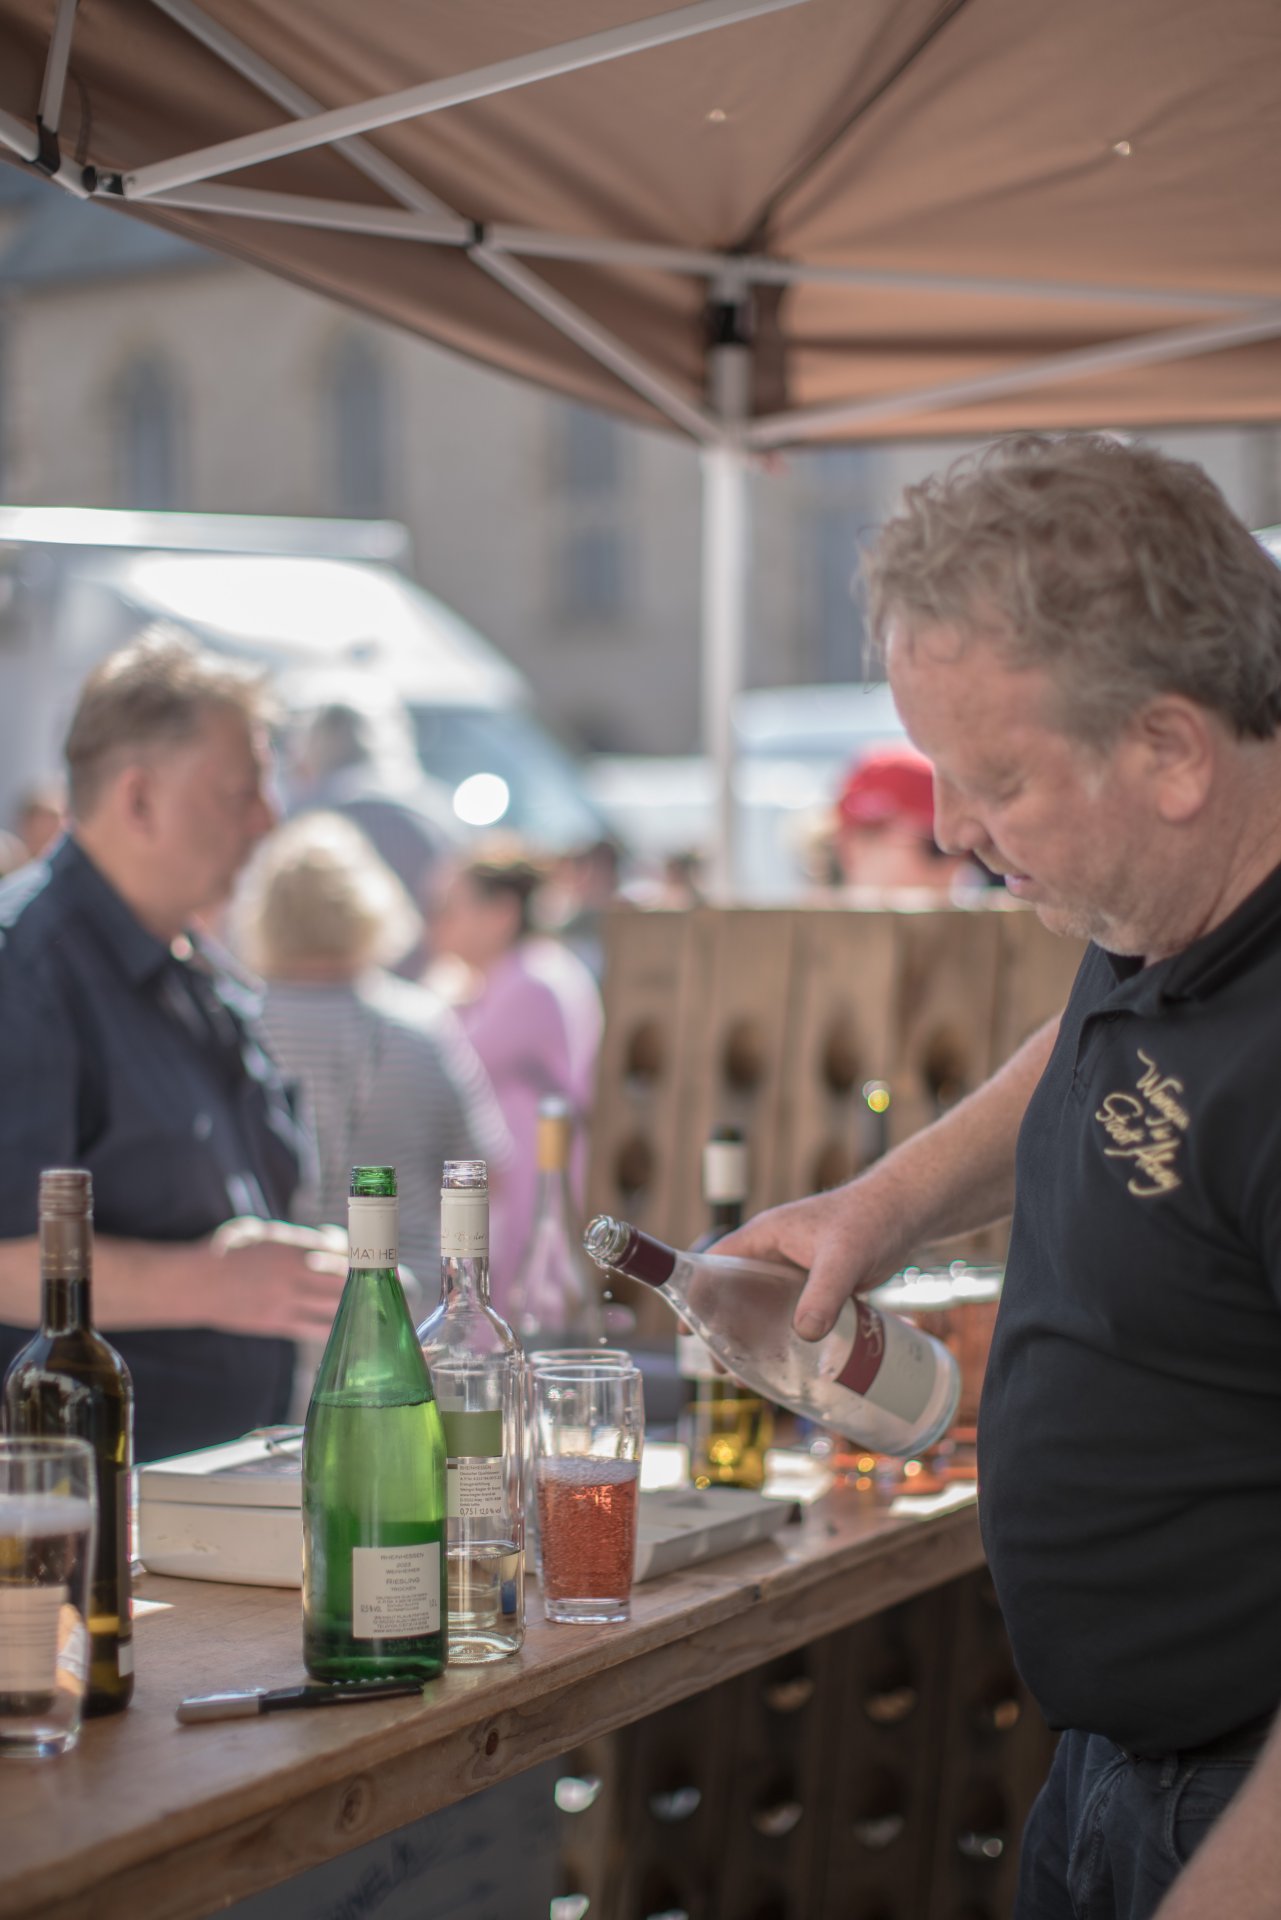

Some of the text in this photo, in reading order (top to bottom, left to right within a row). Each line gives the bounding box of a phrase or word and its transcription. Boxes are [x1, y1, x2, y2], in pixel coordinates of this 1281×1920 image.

[460, 1508, 473, 1516] 0,75
[381, 1552, 424, 1560] RHEINHESSEN
[386, 1577, 420, 1585] RIESLING
